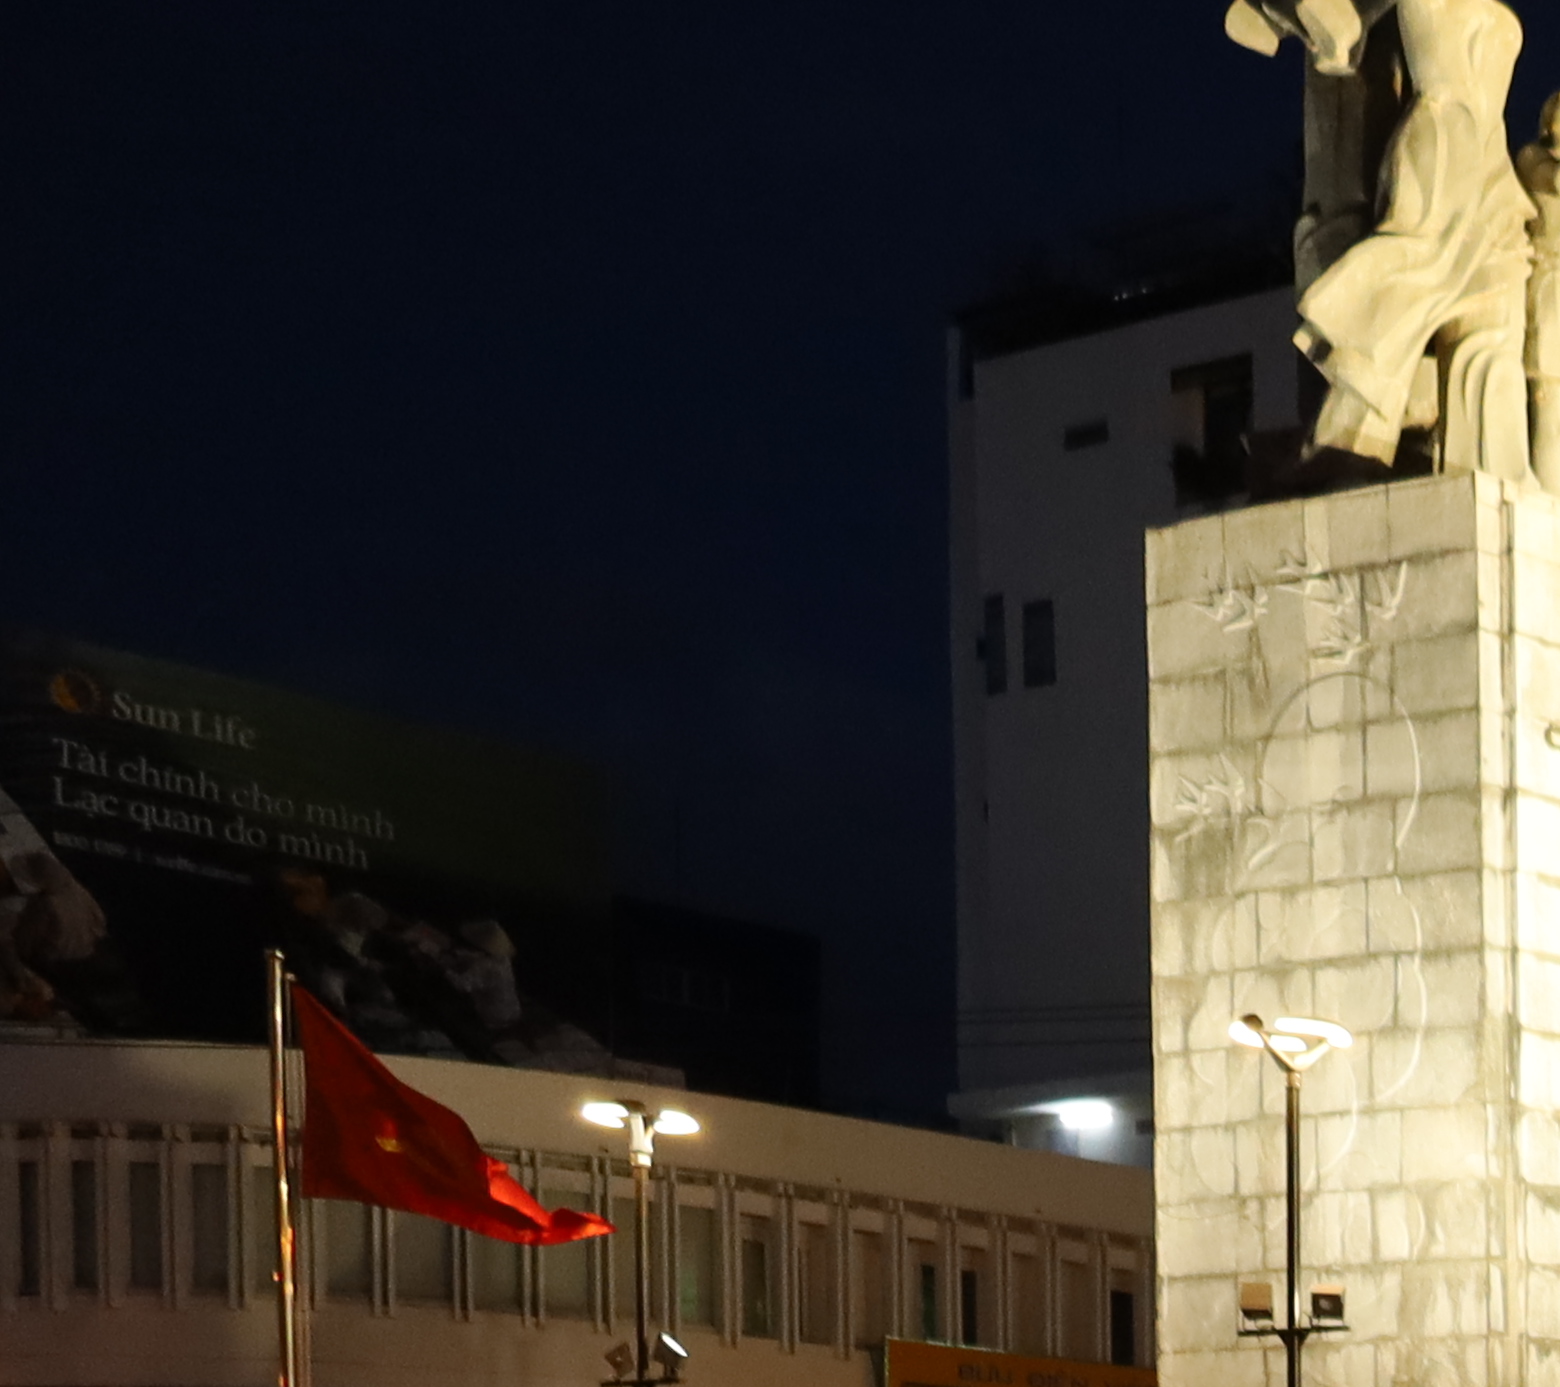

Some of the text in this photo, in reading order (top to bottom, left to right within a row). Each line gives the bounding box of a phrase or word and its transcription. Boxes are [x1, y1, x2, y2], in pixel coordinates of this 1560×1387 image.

[113, 692, 257, 750] Sun Life
[51, 738, 395, 841] Tài chính cho mình
[53, 776, 119, 818] Lạc
[130, 801, 214, 837] quan
[225, 816, 268, 848] do
[280, 832, 369, 870] mình
